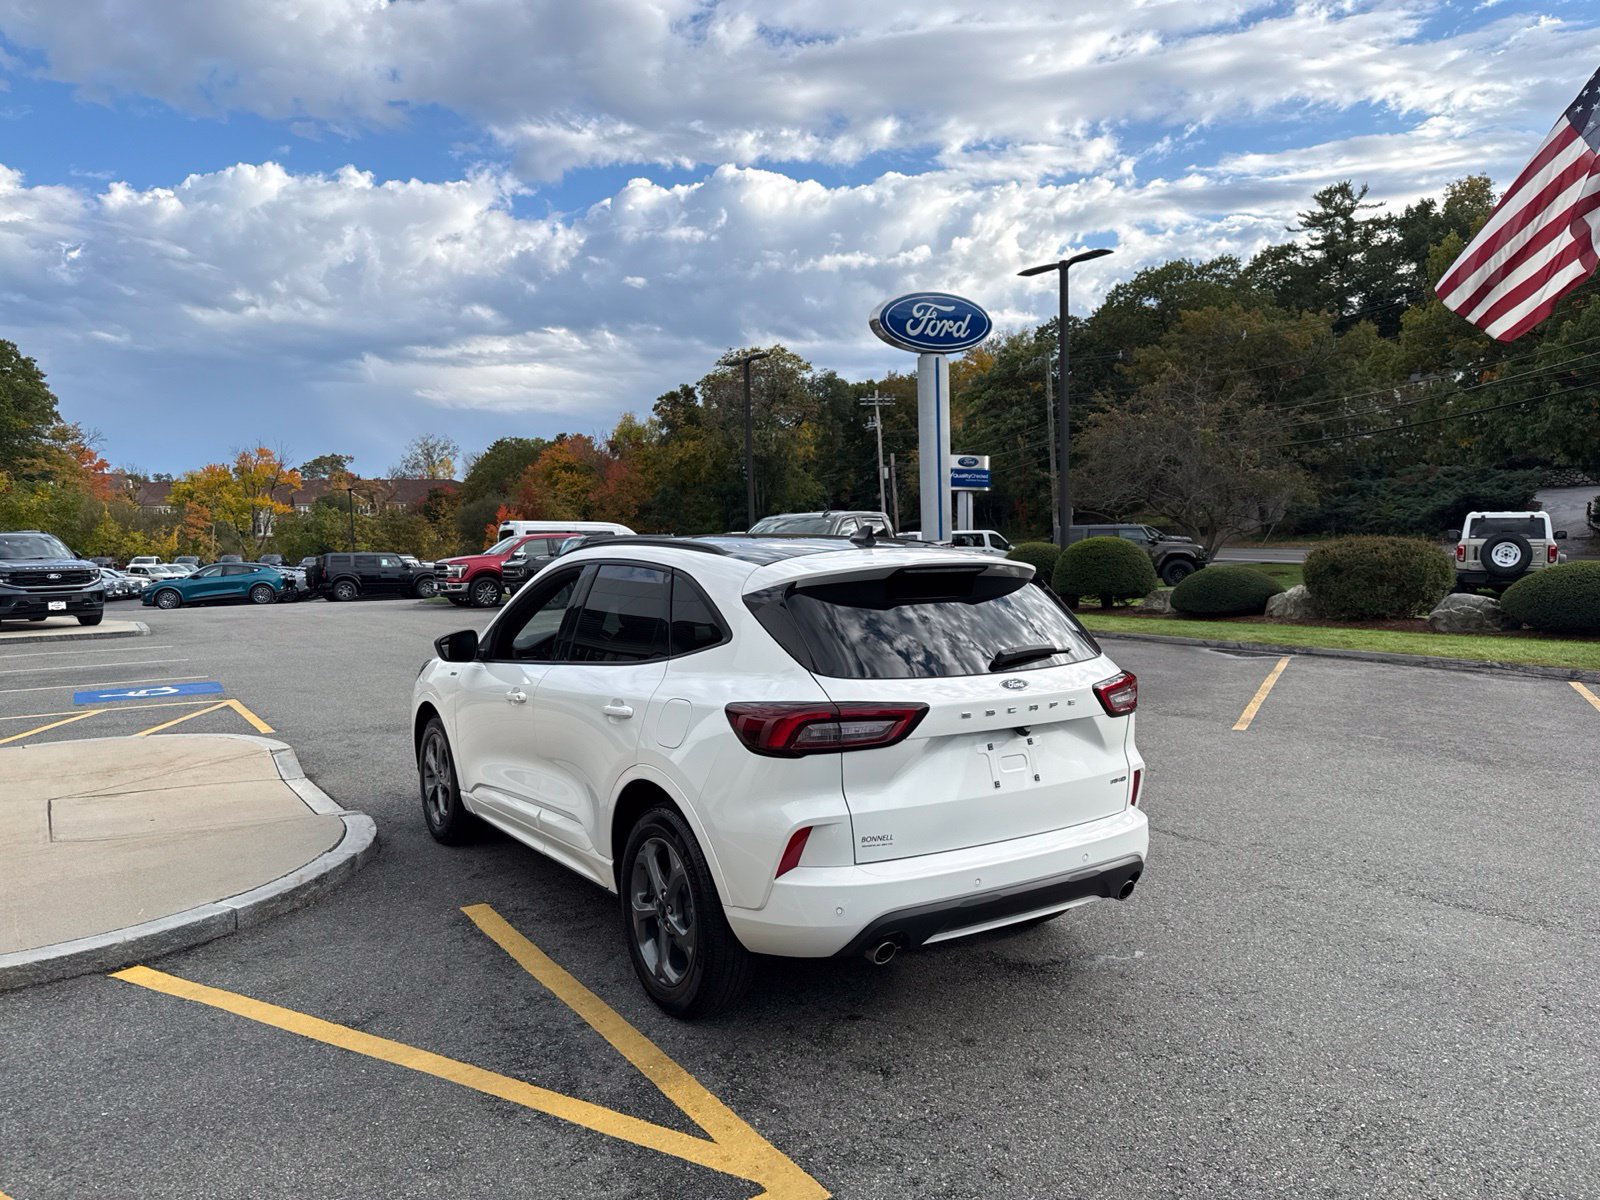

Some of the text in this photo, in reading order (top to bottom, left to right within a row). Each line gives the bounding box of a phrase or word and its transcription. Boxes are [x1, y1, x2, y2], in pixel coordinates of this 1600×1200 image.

[905, 302, 971, 338] Ford
[961, 699, 1076, 719] ESCAPE
[861, 834, 893, 843] BONNELL
